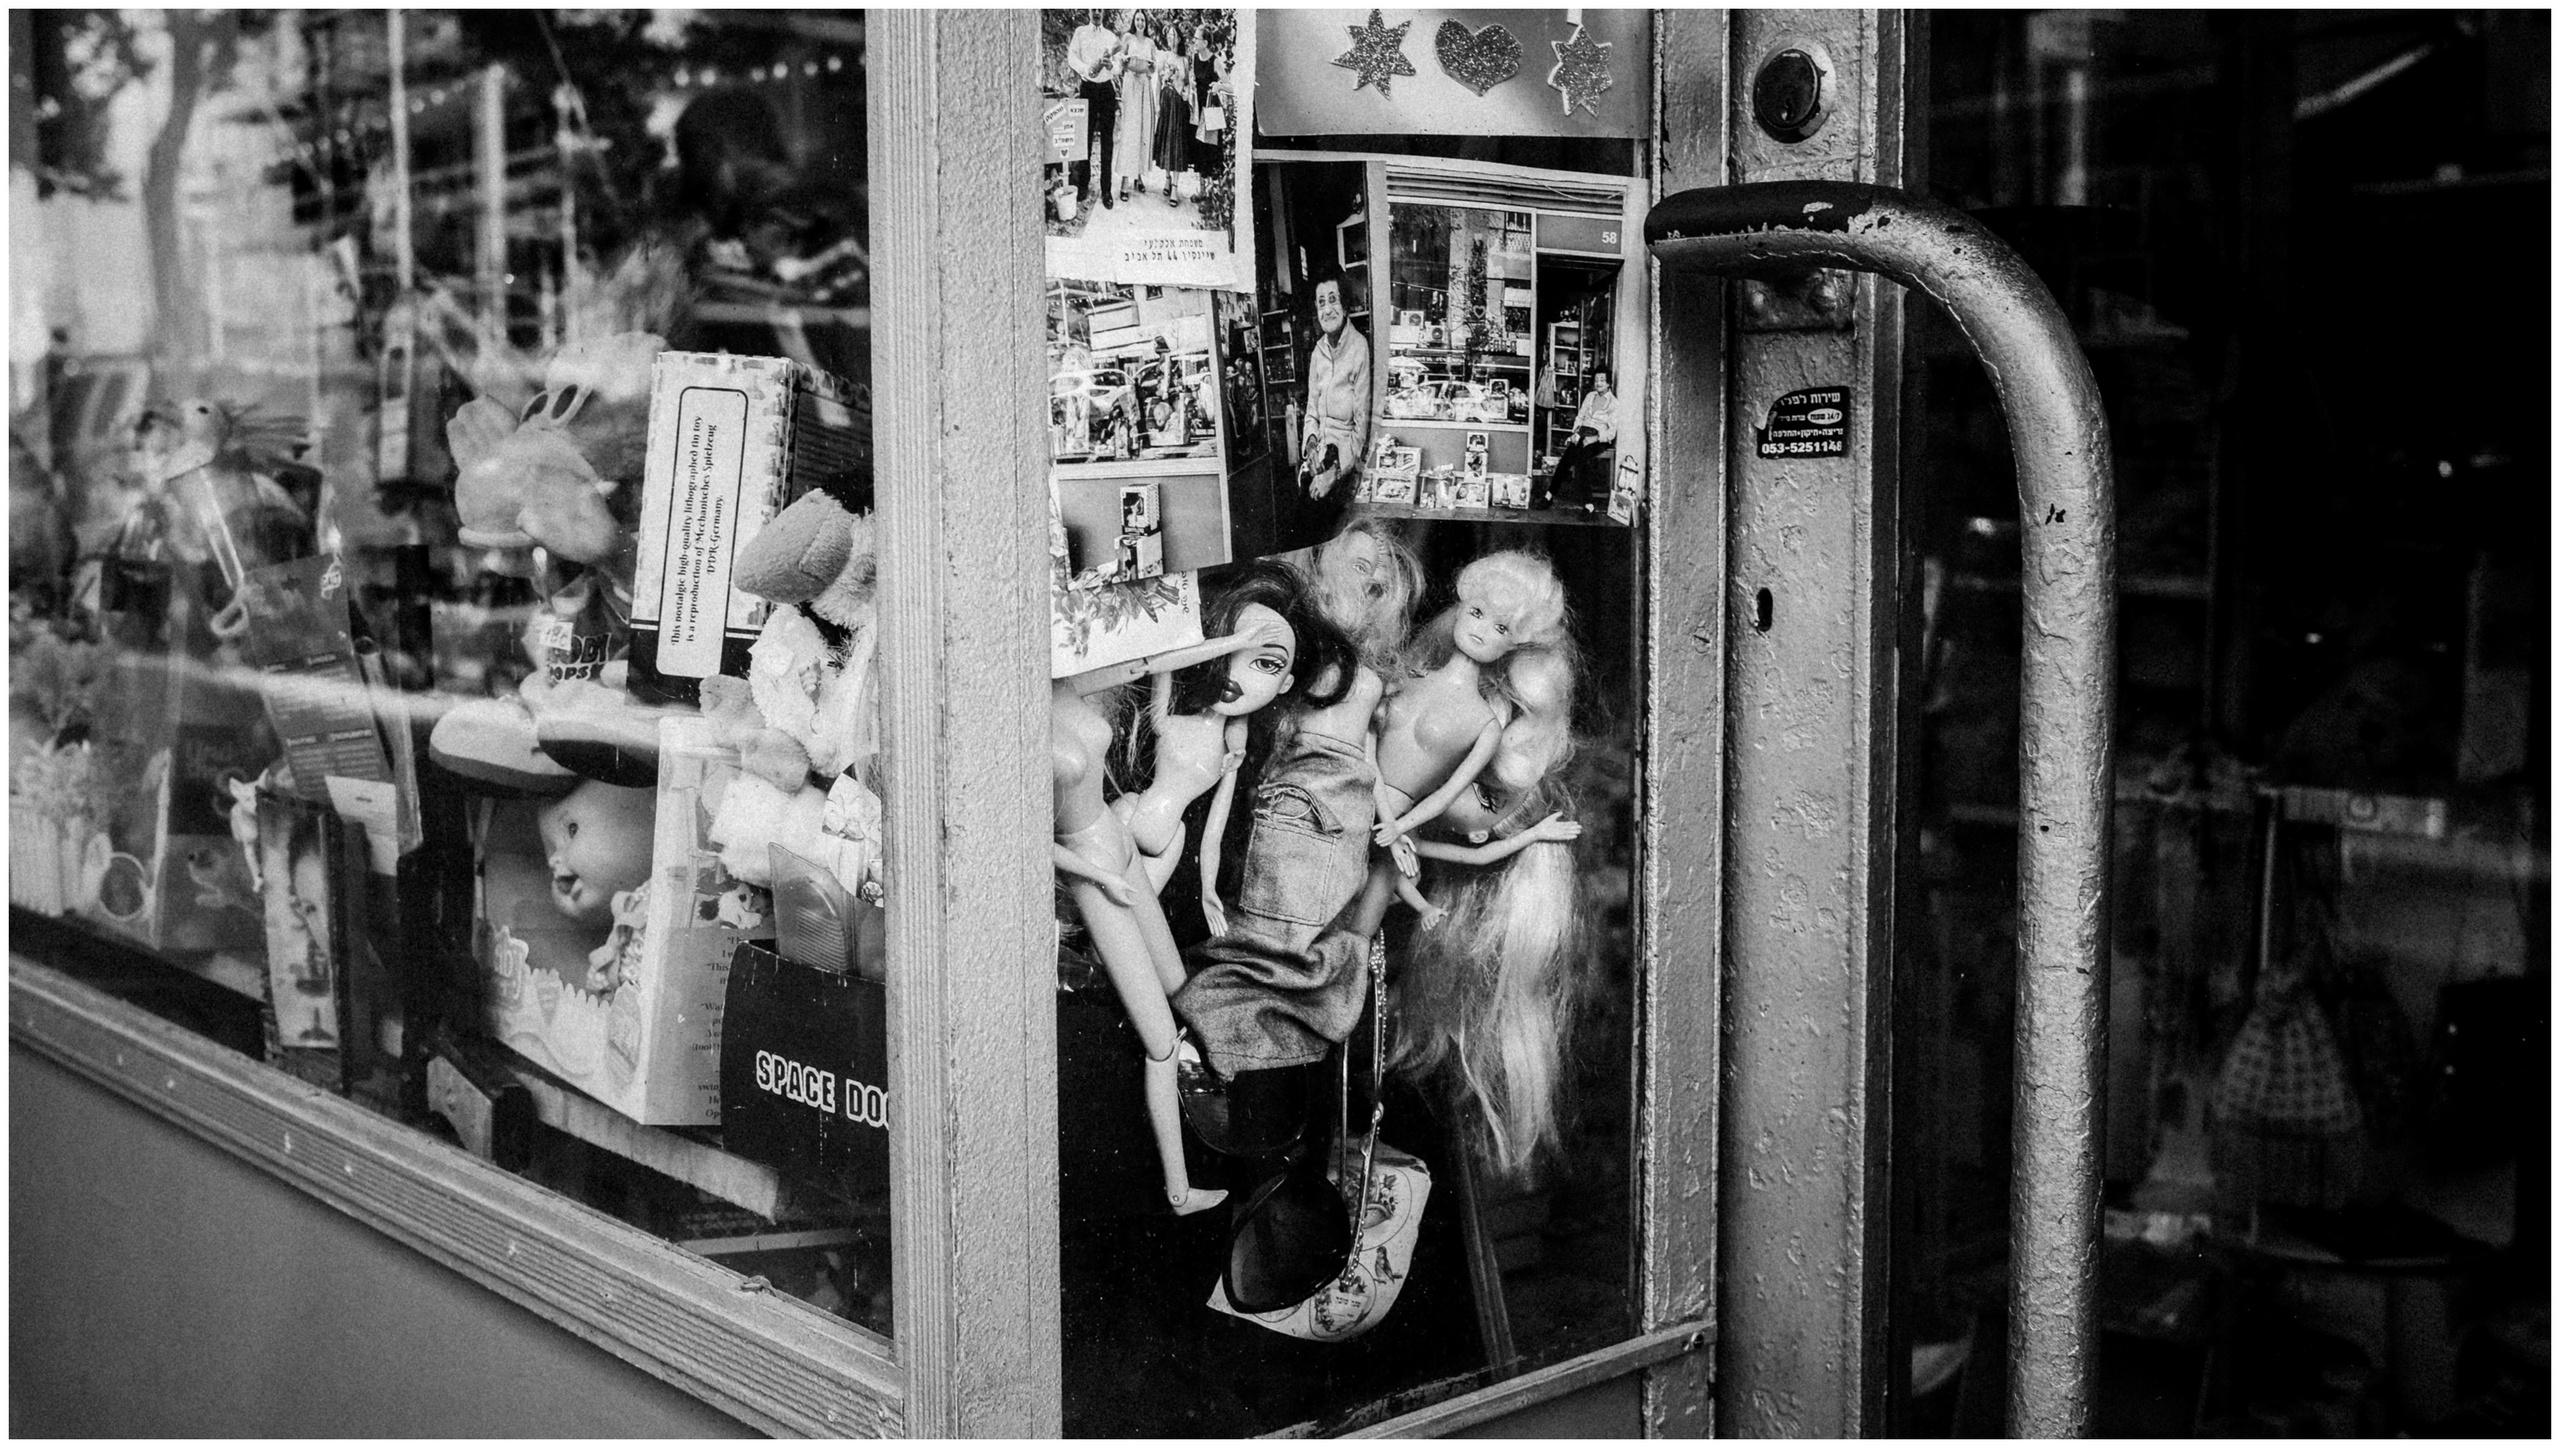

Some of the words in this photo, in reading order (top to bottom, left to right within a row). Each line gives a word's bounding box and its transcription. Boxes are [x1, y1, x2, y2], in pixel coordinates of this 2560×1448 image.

[1602, 231, 1617, 244] 58
[1124, 252, 1148, 262] אביב
[1151, 251, 1163, 261] תל
[1809, 392, 1841, 404] שירות
[692, 415, 703, 432] toy
[691, 434, 701, 449] tin
[702, 424, 717, 472] Spielzeug
[683, 451, 700, 513] lithographed
[694, 474, 711, 545] Mechanisches
[677, 516, 694, 576] high-quality
[694, 547, 705, 557] of
[674, 578, 688, 622] nostalgic
[689, 559, 703, 623] reproduction
[671, 625, 682, 646] This
[686, 633, 695, 642] is
[756, 1049, 836, 1114] SPACE
[846, 1078, 889, 1131] DO
